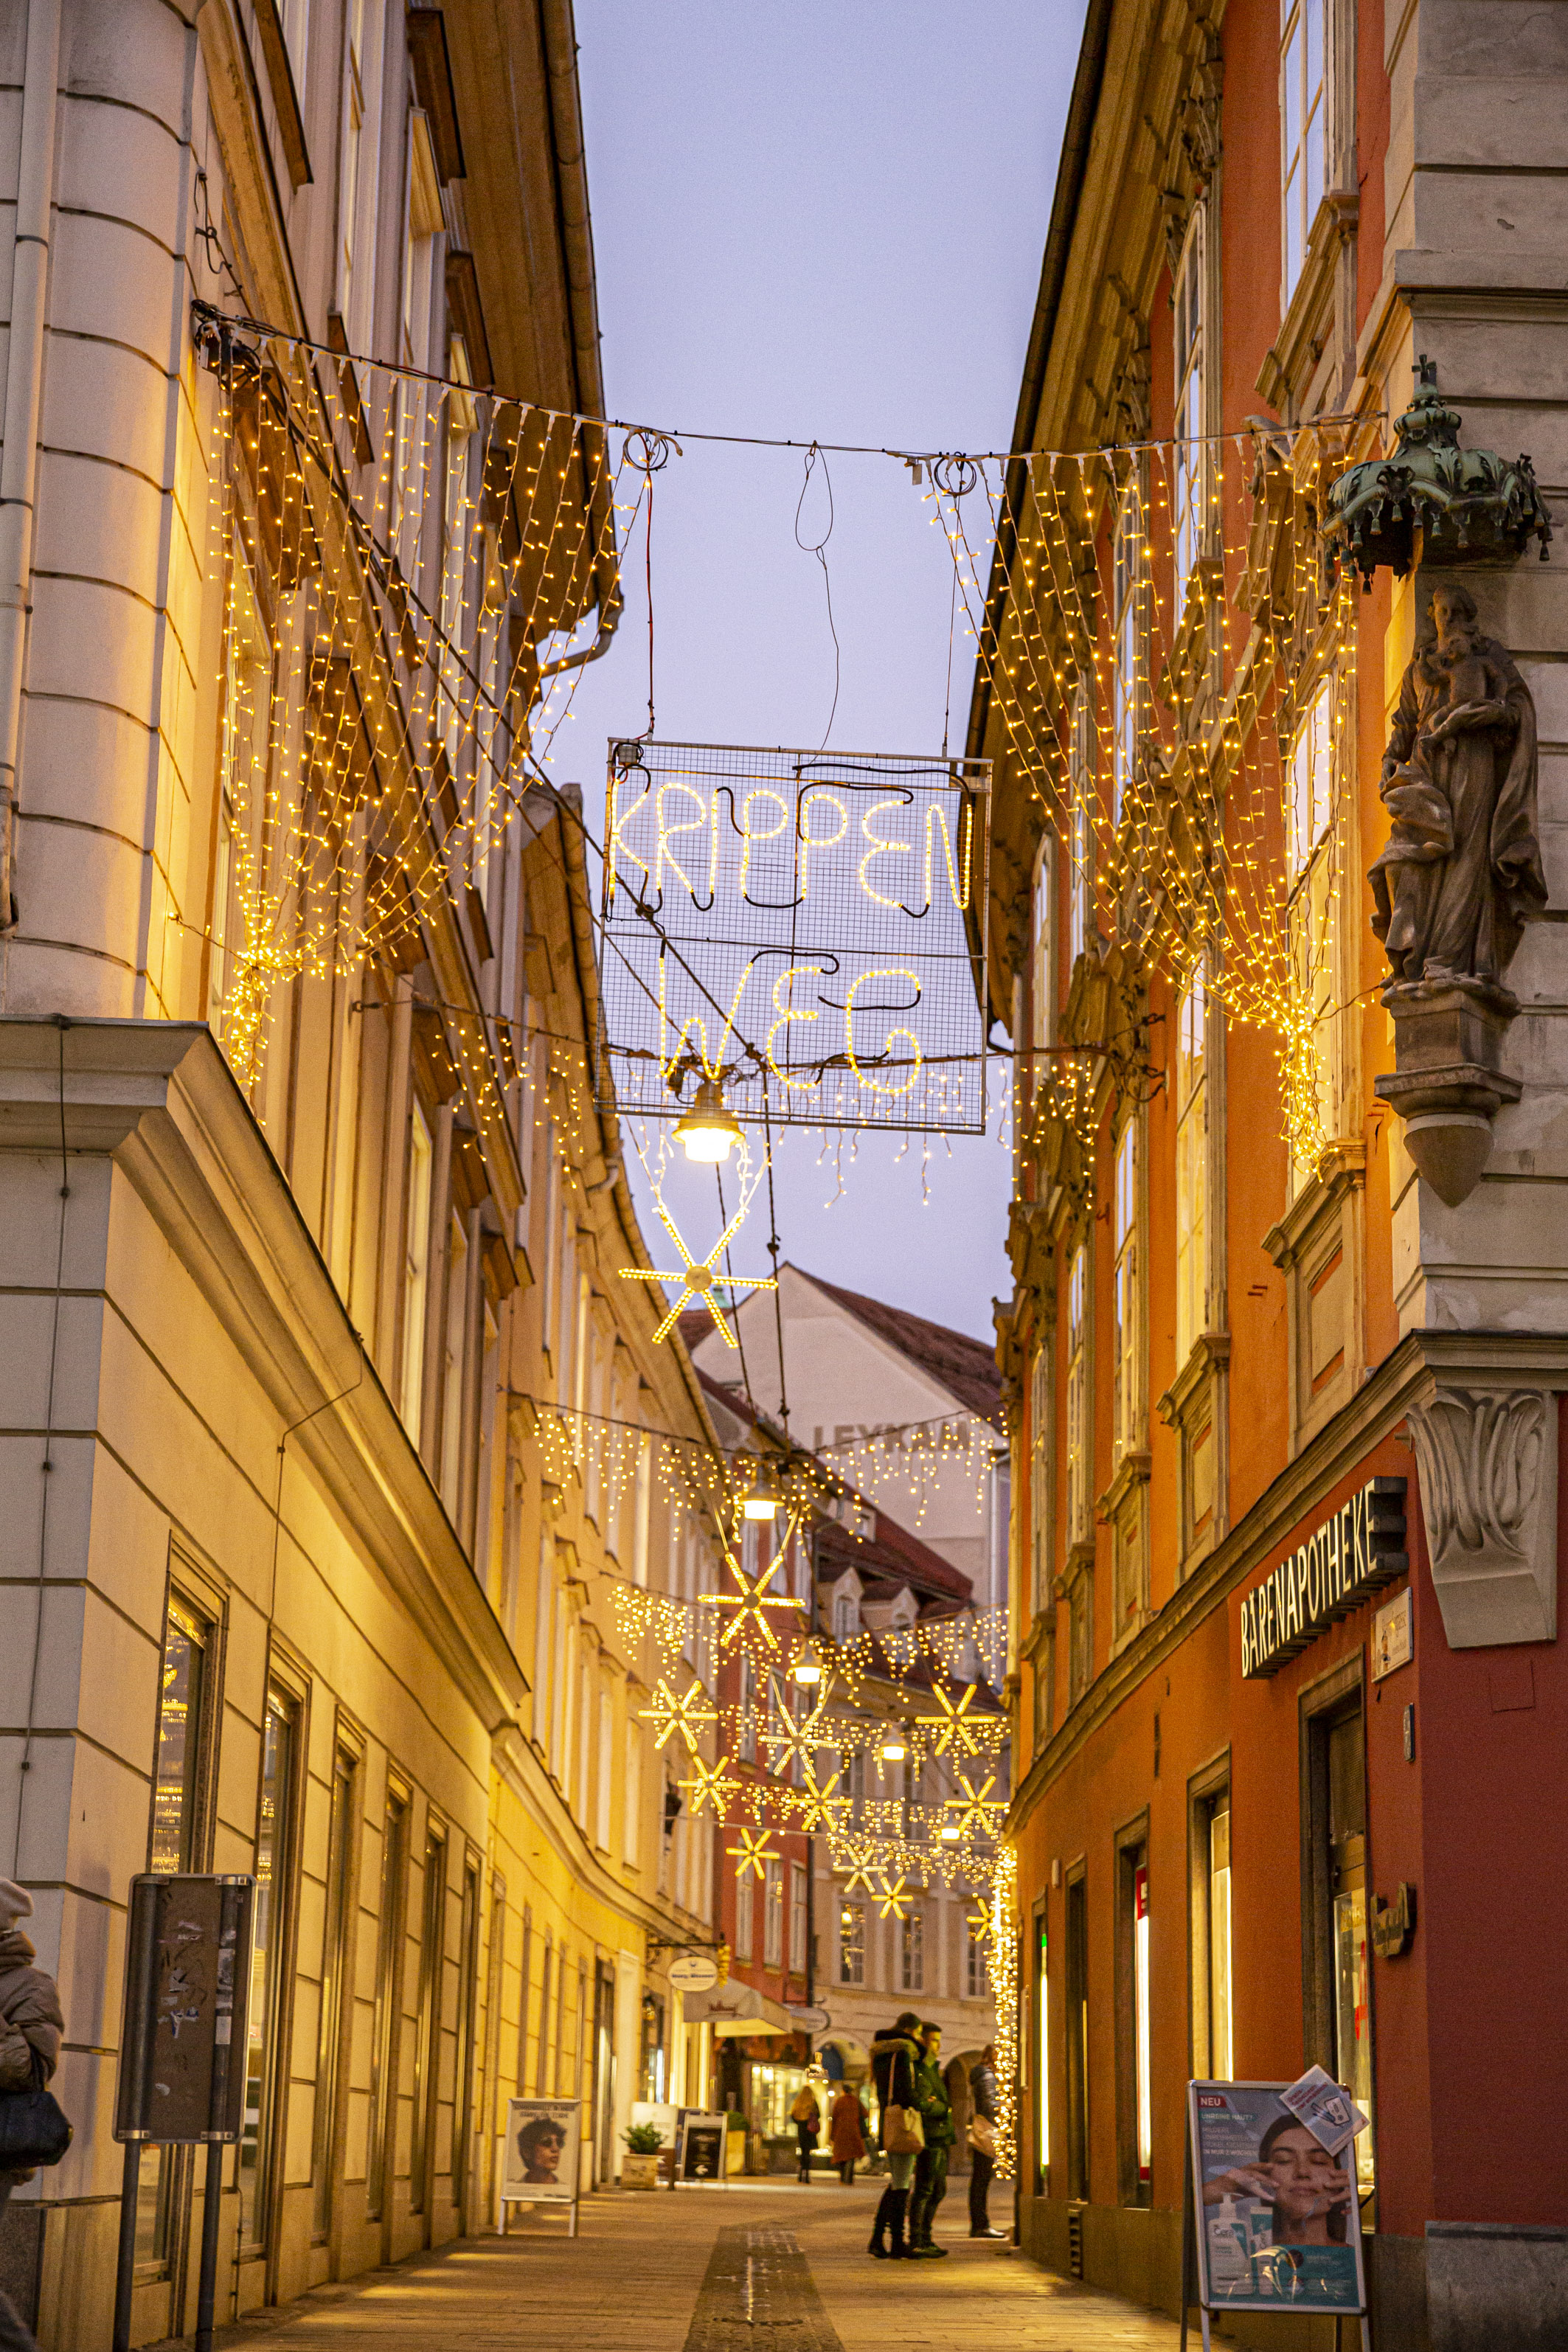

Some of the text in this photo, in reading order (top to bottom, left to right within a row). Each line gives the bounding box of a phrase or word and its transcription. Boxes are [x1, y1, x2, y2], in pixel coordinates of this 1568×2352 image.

[607, 777, 974, 911] KRIPPEN
[659, 957, 922, 1094] WEG
[1240, 1475, 1378, 1679] BÄRENAPOTHEKE
[1200, 2097, 1221, 2106] NEU
